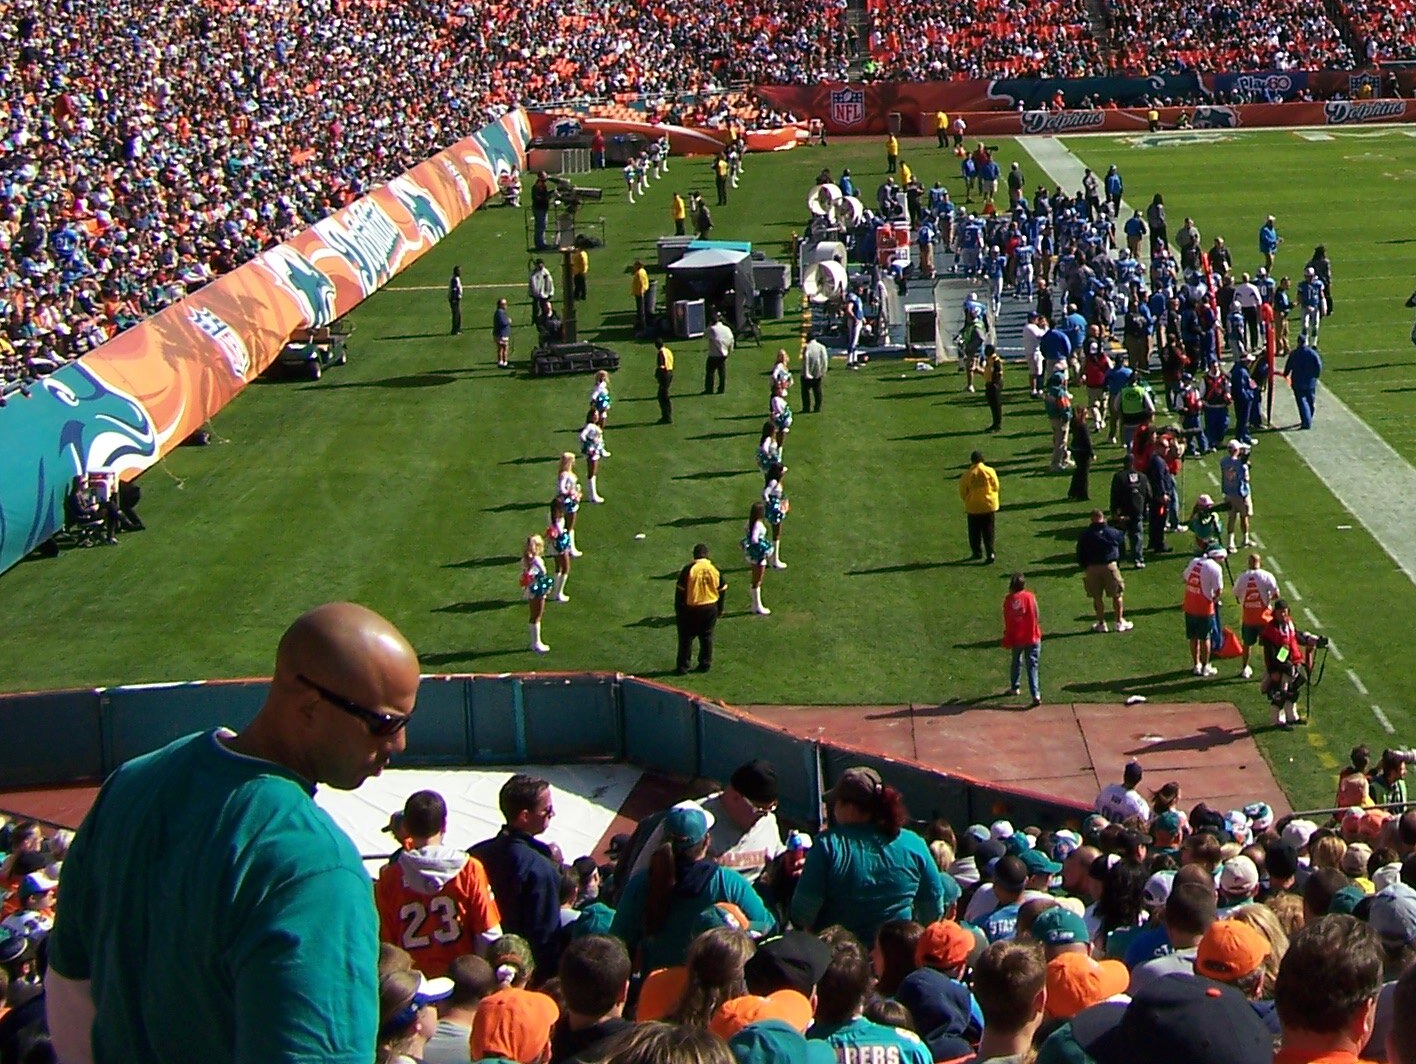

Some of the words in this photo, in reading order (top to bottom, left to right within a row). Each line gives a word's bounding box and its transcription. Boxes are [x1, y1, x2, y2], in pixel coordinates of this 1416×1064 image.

[835, 102, 863, 120] NFL
[1022, 110, 1105, 134] Dolphins
[1325, 100, 1407, 125] Dolphins
[399, 895, 462, 949] 23
